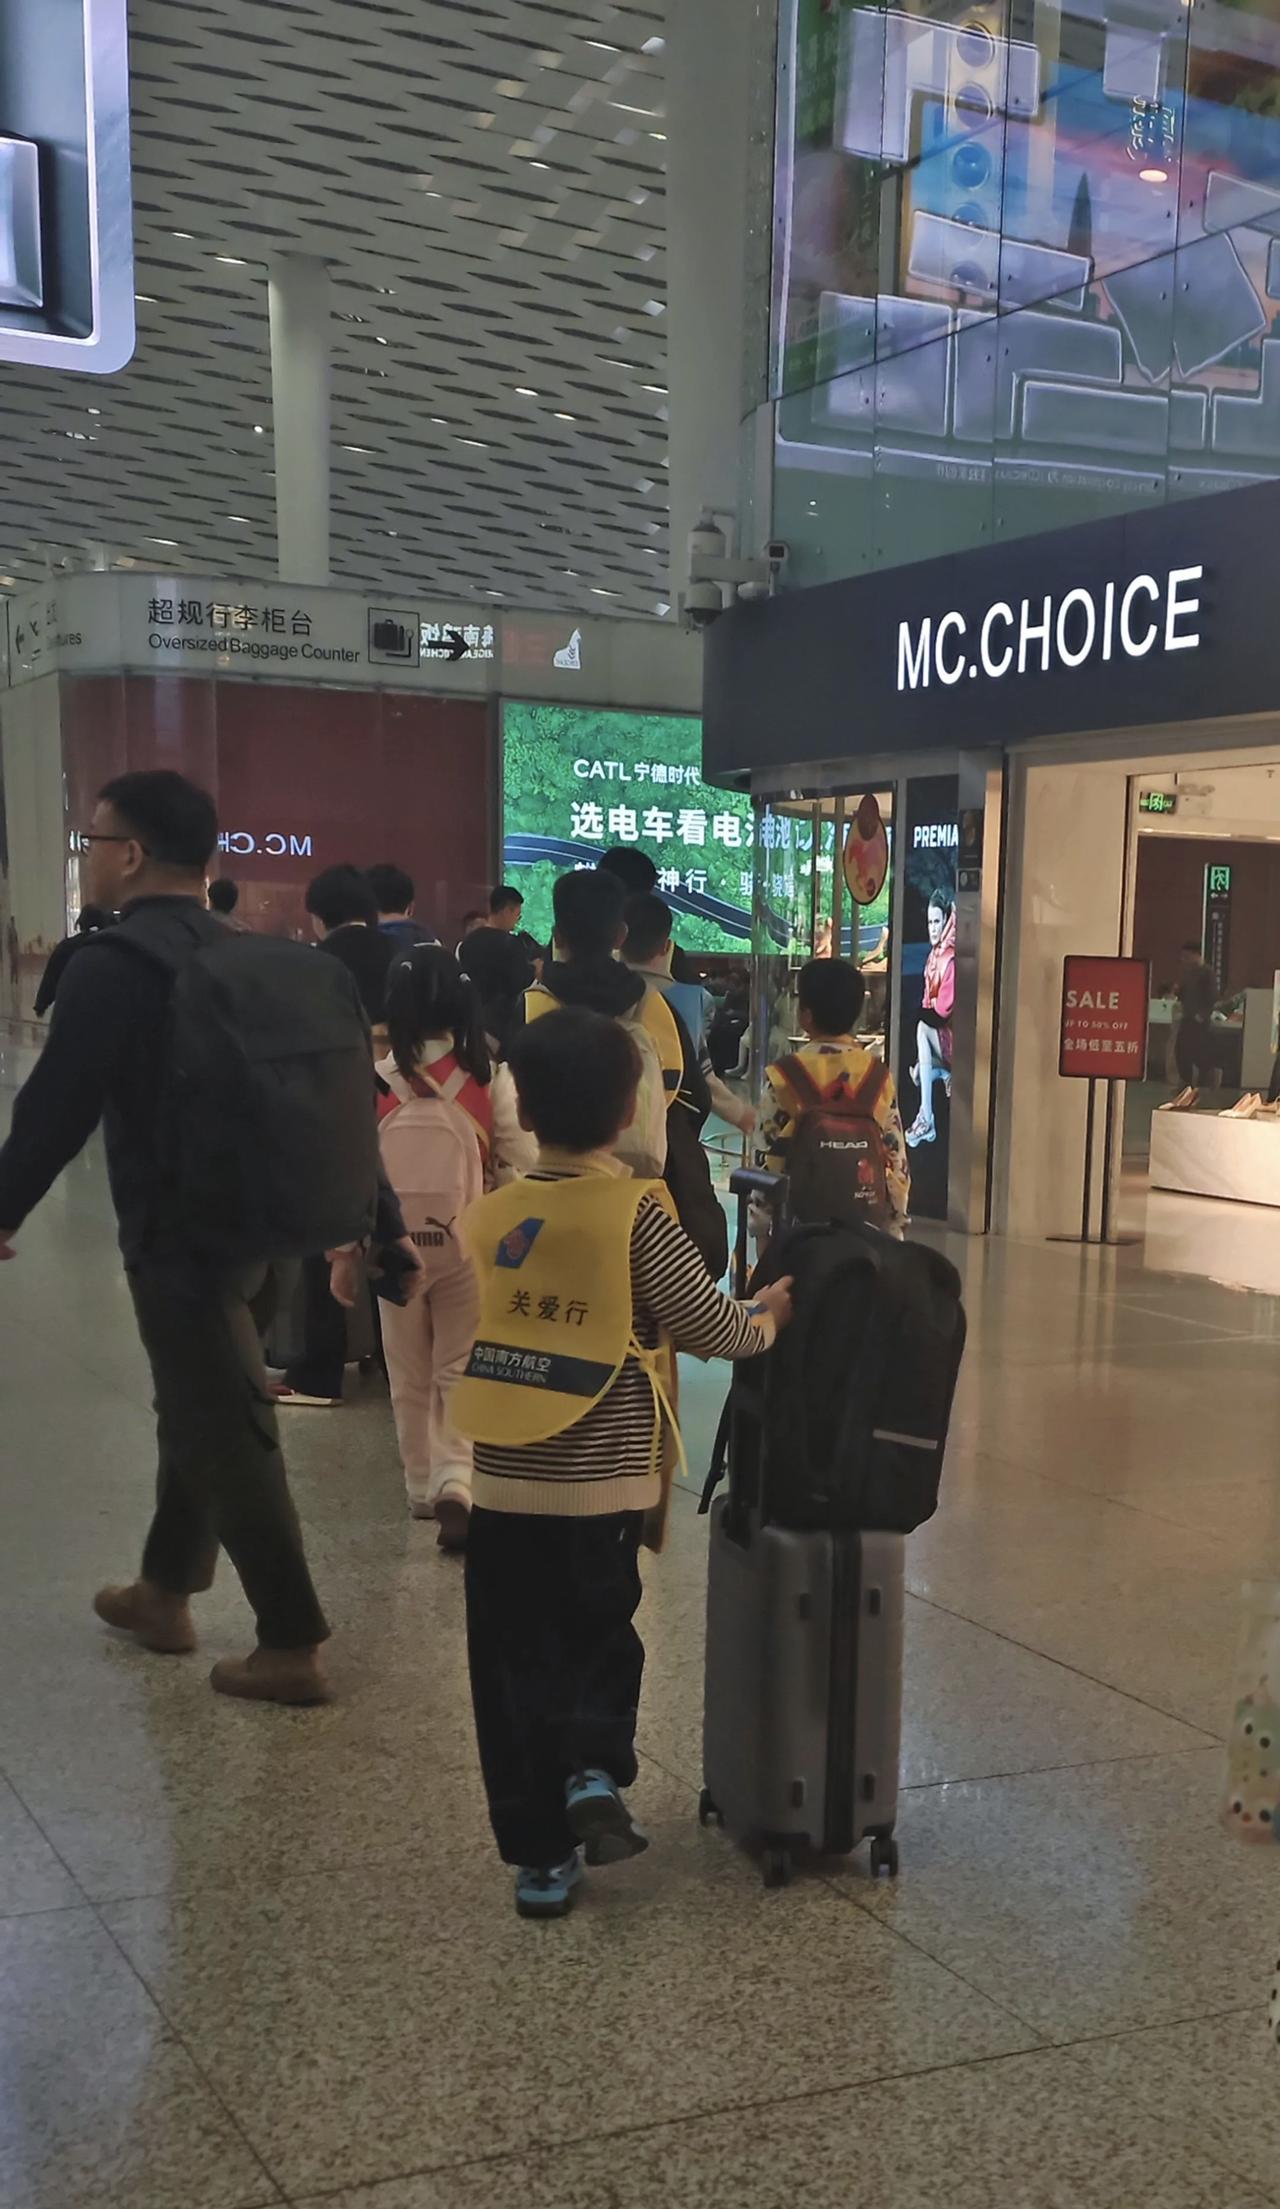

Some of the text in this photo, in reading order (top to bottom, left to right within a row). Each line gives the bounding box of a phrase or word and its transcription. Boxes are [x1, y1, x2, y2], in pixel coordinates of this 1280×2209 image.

[148, 598, 312, 637] 超规行李柜台
[897, 566, 1202, 690] MC.CHOICE
[149, 633, 360, 663] Oversized Baggage Counter
[573, 759, 701, 786] CATL 宁德时代
[913, 824, 959, 848] PREMIA
[656, 866, 708, 894] 神行
[1065, 990, 1120, 1010] SALE
[1063, 1038, 1139, 1054] 全场低至五折
[820, 1140, 869, 1149] HEAD
[507, 1288, 589, 1327] 关爱行
[473, 1346, 552, 1373] 中国南方航空
